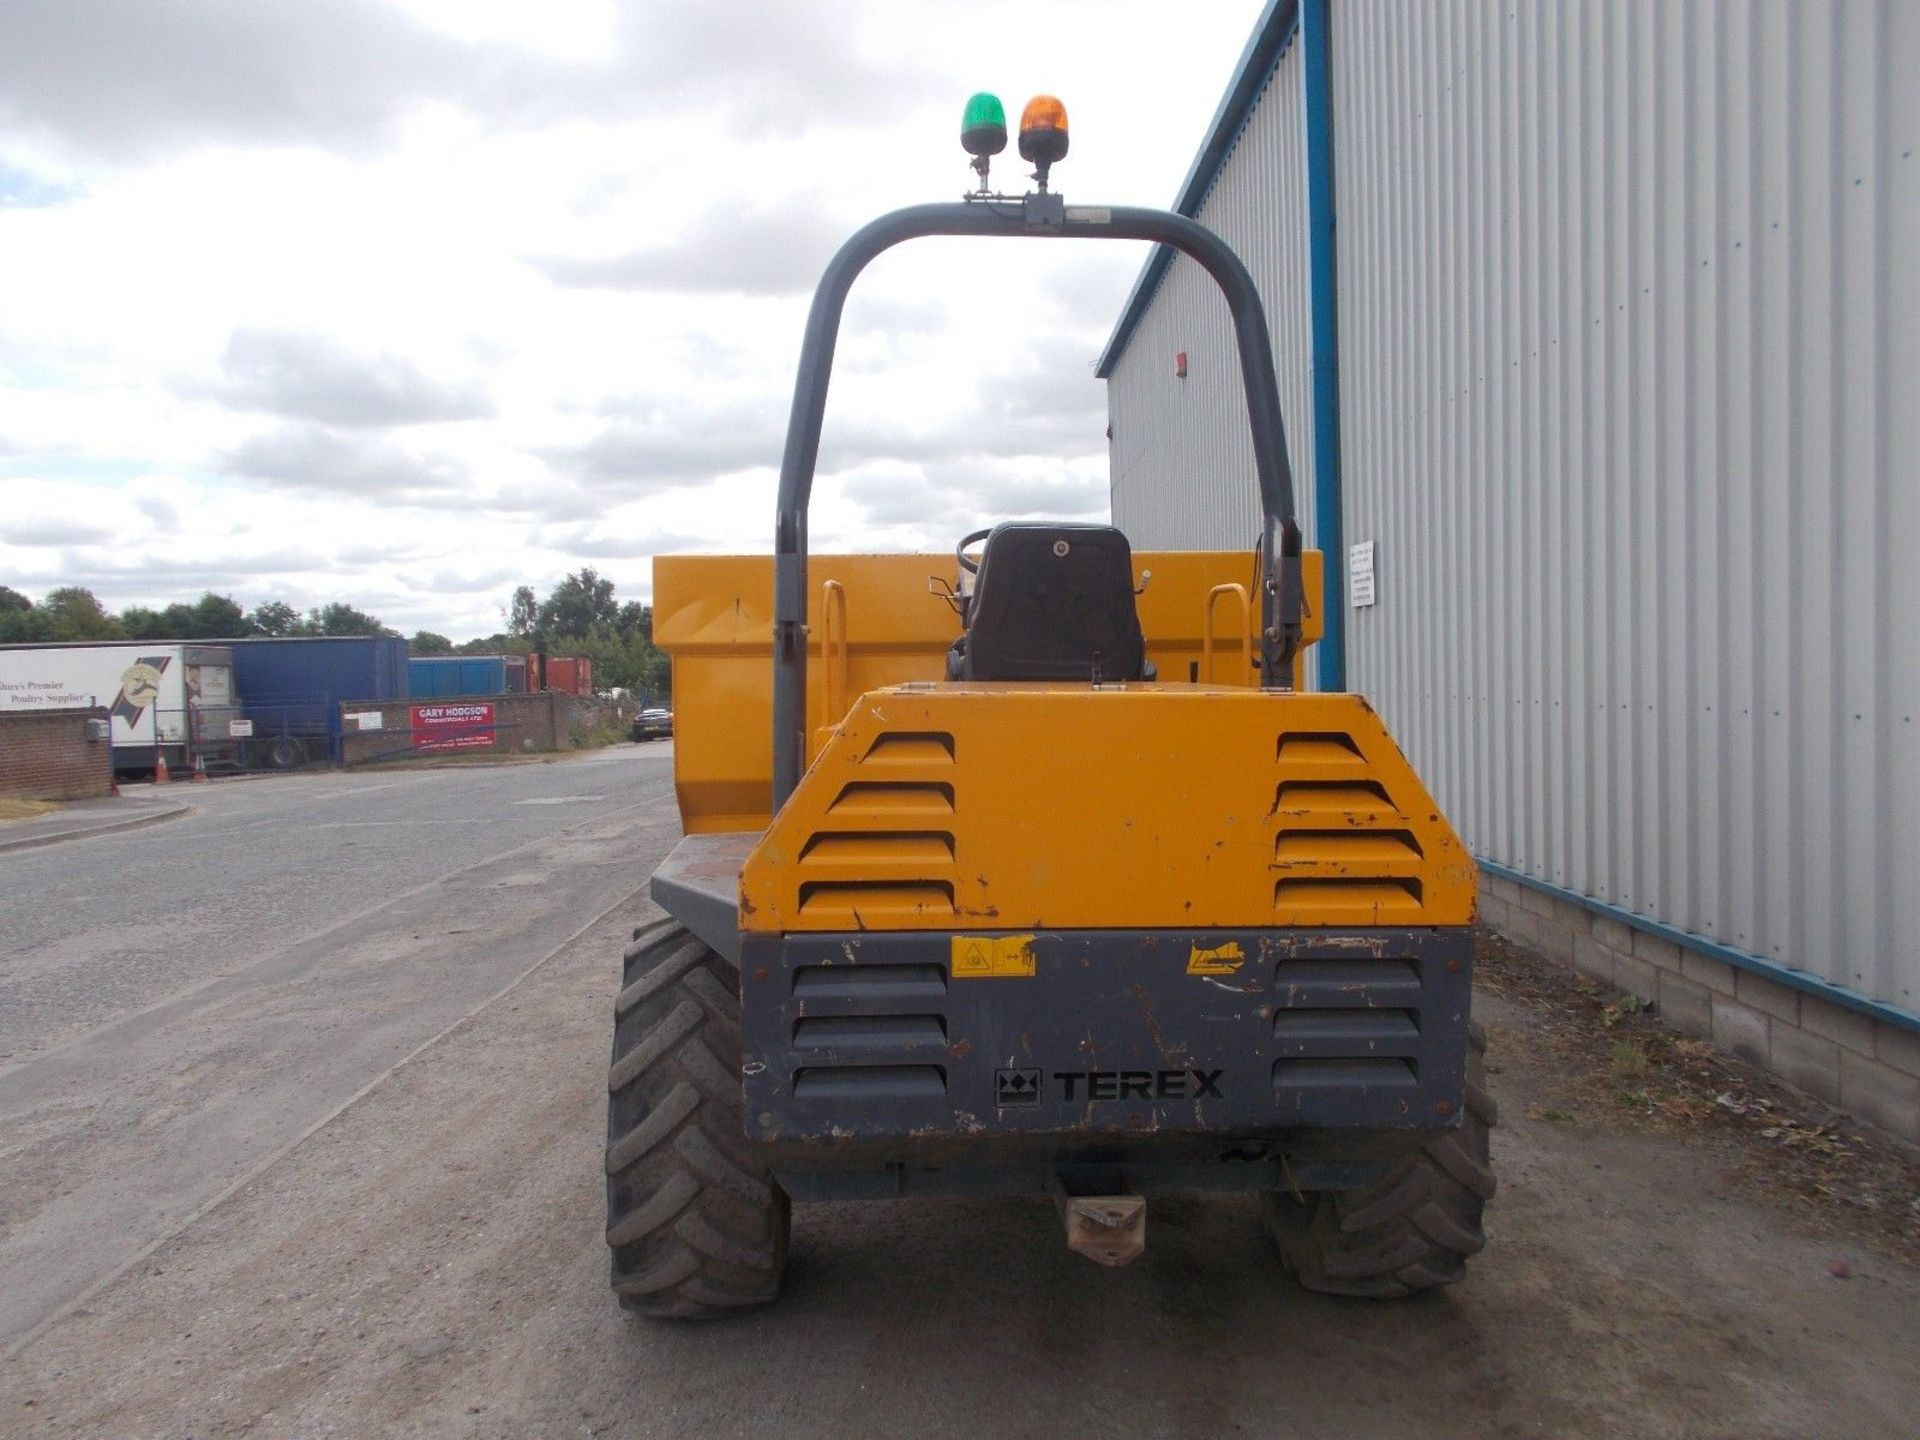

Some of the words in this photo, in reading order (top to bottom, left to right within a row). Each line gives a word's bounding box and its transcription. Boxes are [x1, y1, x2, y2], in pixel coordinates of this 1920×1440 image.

[28, 681, 64, 690] Premier
[11, 695, 43, 704] Poultry
[47, 693, 83, 703] Supplier
[419, 708, 444, 717] GARY
[446, 706, 488, 716] HODGSON
[1053, 1069, 1224, 1100] TEREX
